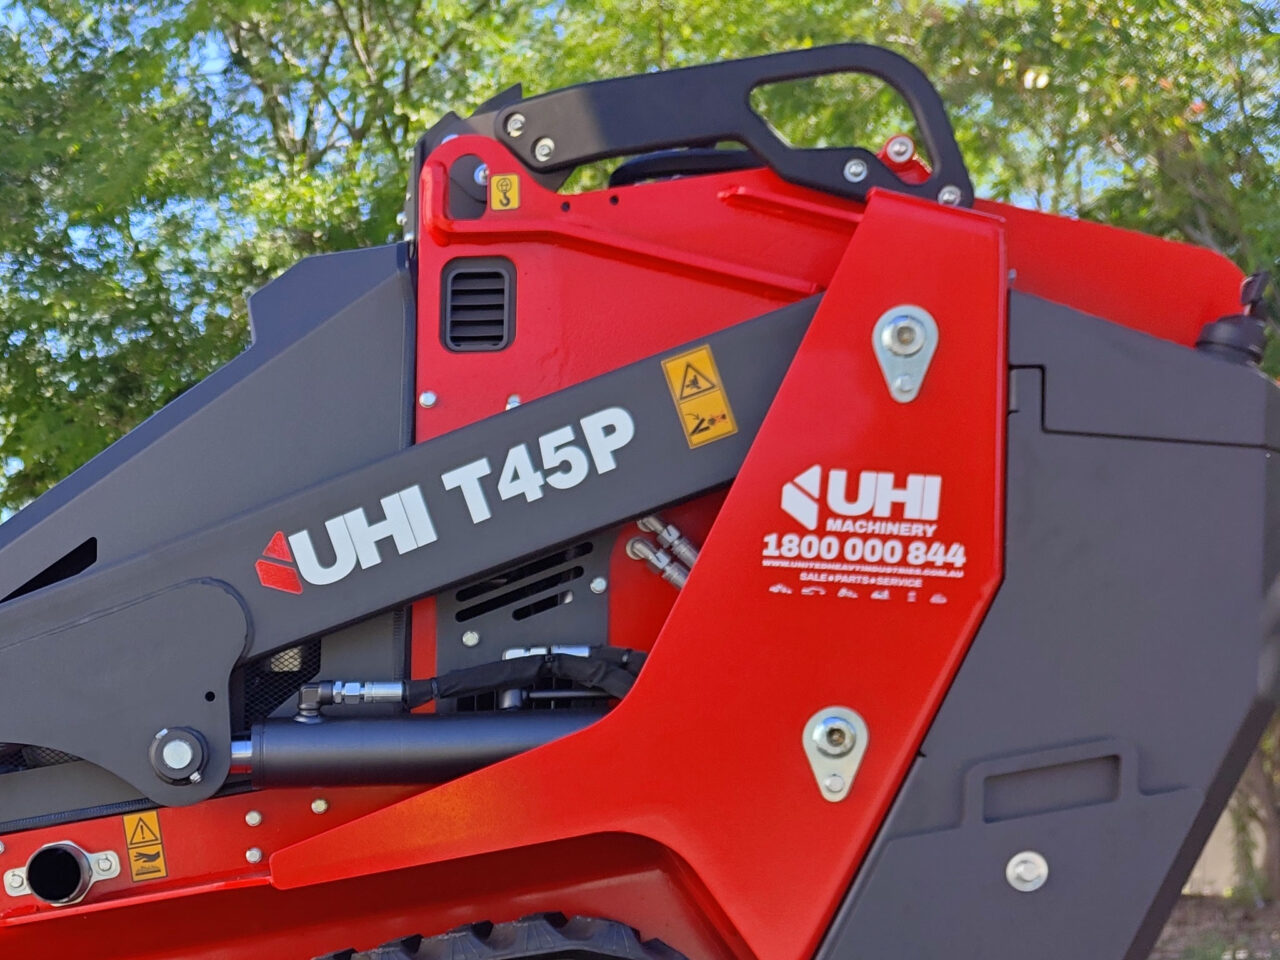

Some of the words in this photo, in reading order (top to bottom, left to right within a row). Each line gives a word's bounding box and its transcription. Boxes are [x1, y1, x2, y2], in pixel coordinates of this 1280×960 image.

[288, 484, 438, 586] UHI
[440, 406, 635, 524] T45P
[826, 468, 942, 521] UHI
[762, 532, 839, 560] 1800
[843, 537, 903, 564] 000
[907, 541, 966, 567] 844
[825, 518, 937, 537] MACHINERY
